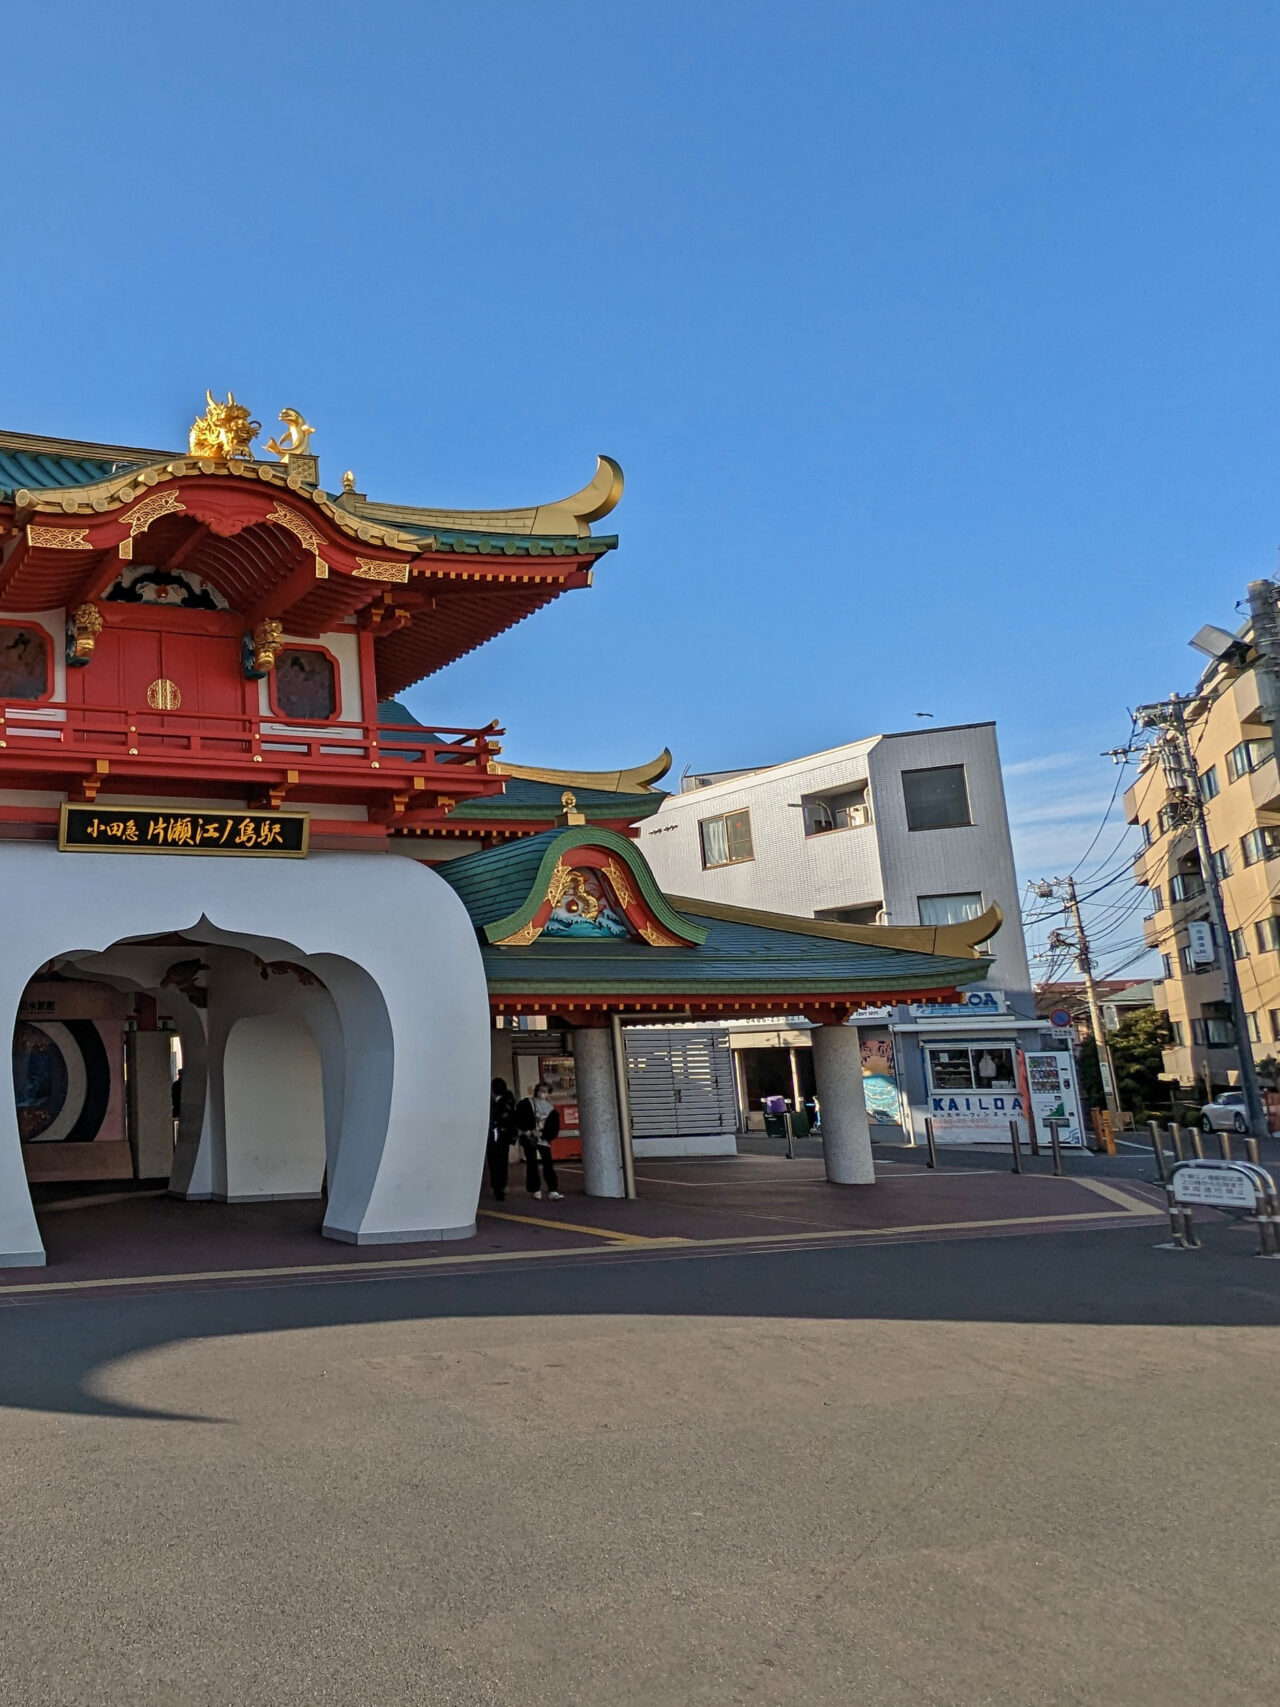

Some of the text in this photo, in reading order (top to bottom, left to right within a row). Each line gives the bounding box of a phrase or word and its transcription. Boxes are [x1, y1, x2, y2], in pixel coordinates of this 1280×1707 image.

[86, 816, 285, 848] 小田急 片瀬江ノ島駅
[932, 1097, 1023, 1111] KAILOA
